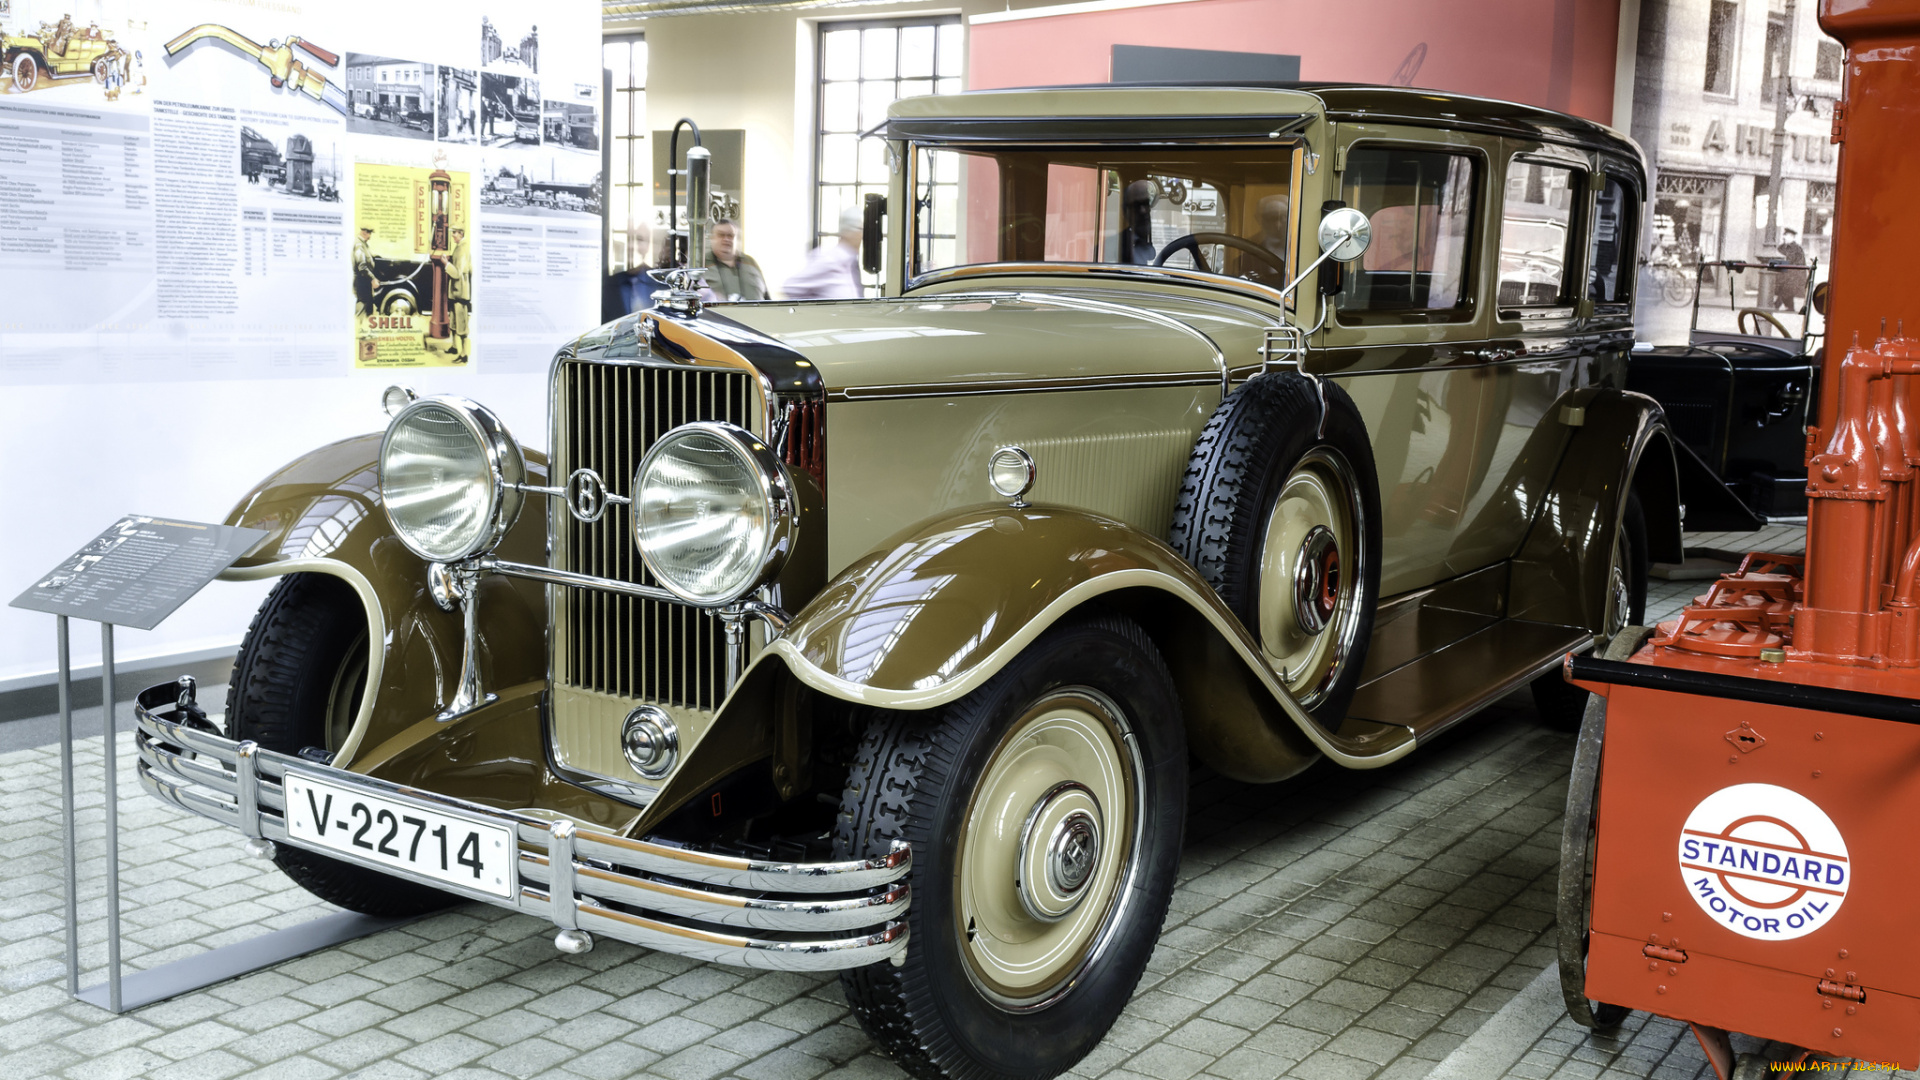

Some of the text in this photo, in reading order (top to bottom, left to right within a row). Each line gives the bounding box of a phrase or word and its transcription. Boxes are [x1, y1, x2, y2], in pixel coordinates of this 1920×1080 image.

[368, 316, 413, 329] SHELL
[306, 787, 485, 879] V-22714
[1682, 839, 1845, 886] STANDARD
[1694, 877, 1830, 933] MOTOR OIL
